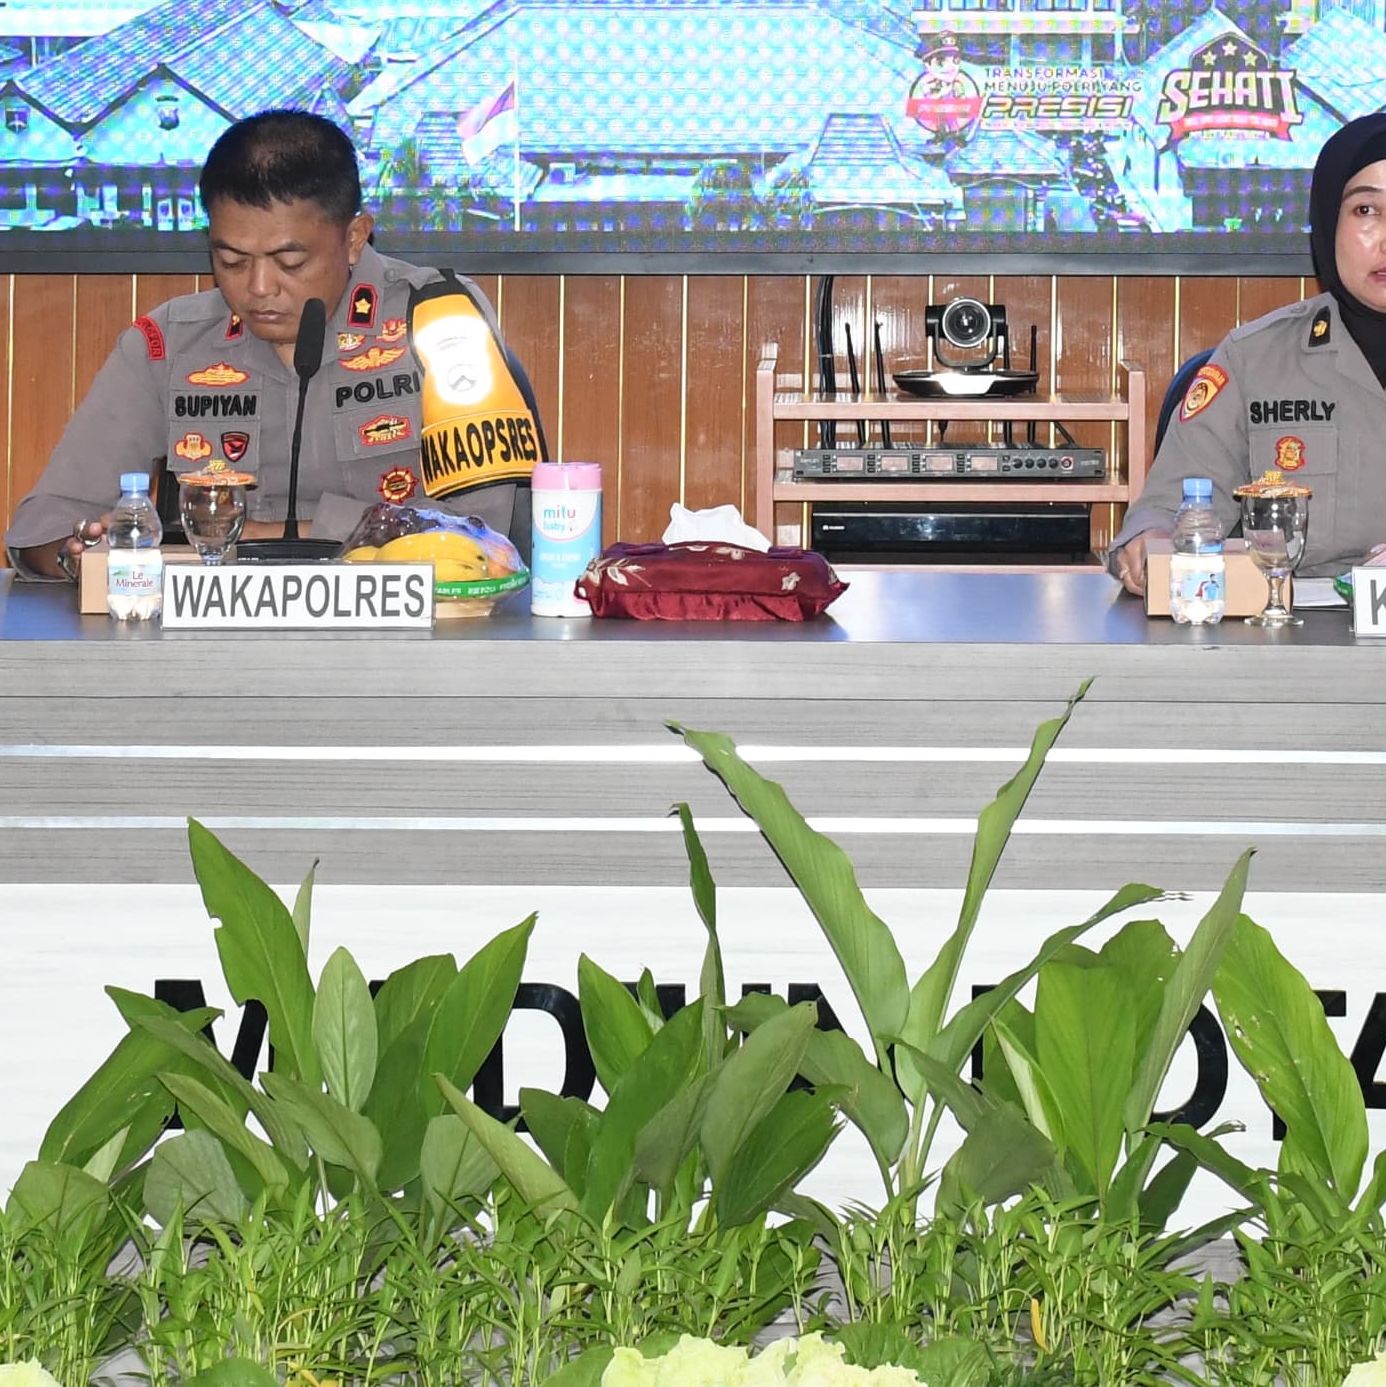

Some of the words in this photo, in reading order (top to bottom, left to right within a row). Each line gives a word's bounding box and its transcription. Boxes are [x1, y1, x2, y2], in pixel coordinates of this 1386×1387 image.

[335, 371, 421, 408] POLRI
[175, 394, 257, 417] SUPIYAN
[1250, 400, 1335, 424] SHERLY
[543, 505, 576, 518] mitu
[115, 577, 154, 589] Minerale
[132, 570, 144, 580] Le
[172, 574, 426, 618] WAKAPOLRES
